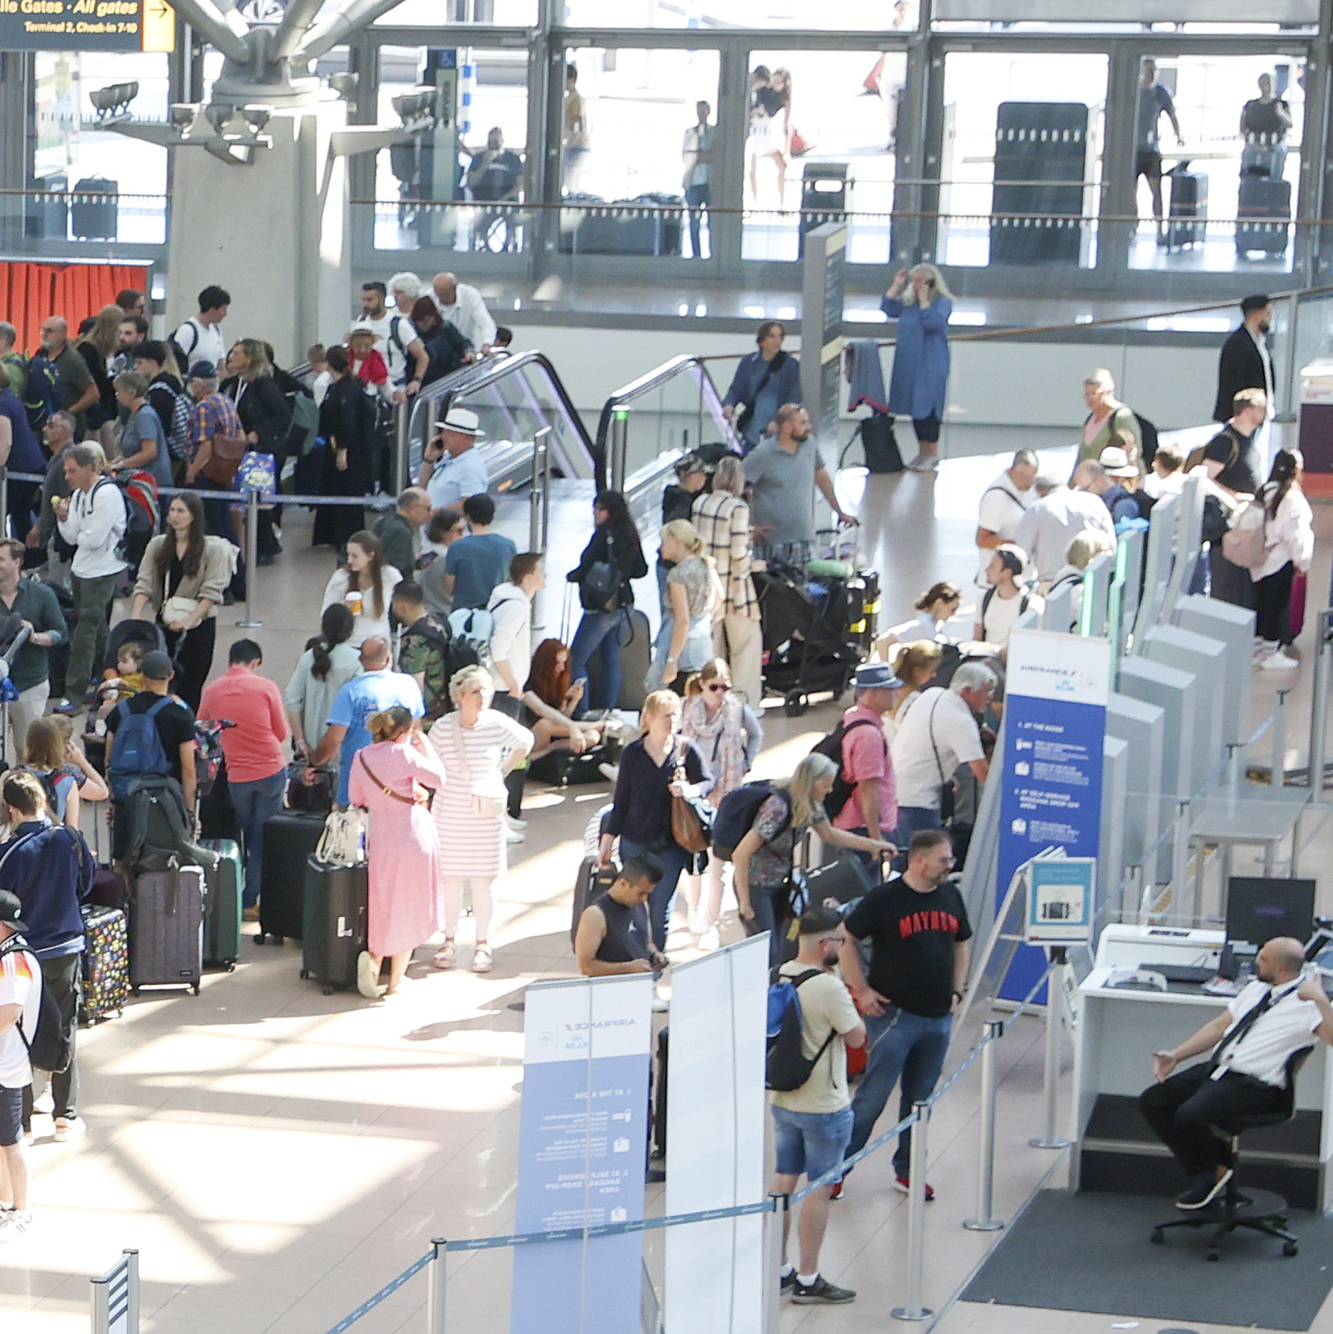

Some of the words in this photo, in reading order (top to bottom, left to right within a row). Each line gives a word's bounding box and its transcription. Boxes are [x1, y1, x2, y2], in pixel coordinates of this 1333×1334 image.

[20, 0, 64, 14] Gates
[73, 0, 95, 14] All
[96, 0, 138, 17] gates
[24, 21, 65, 32] Terminal
